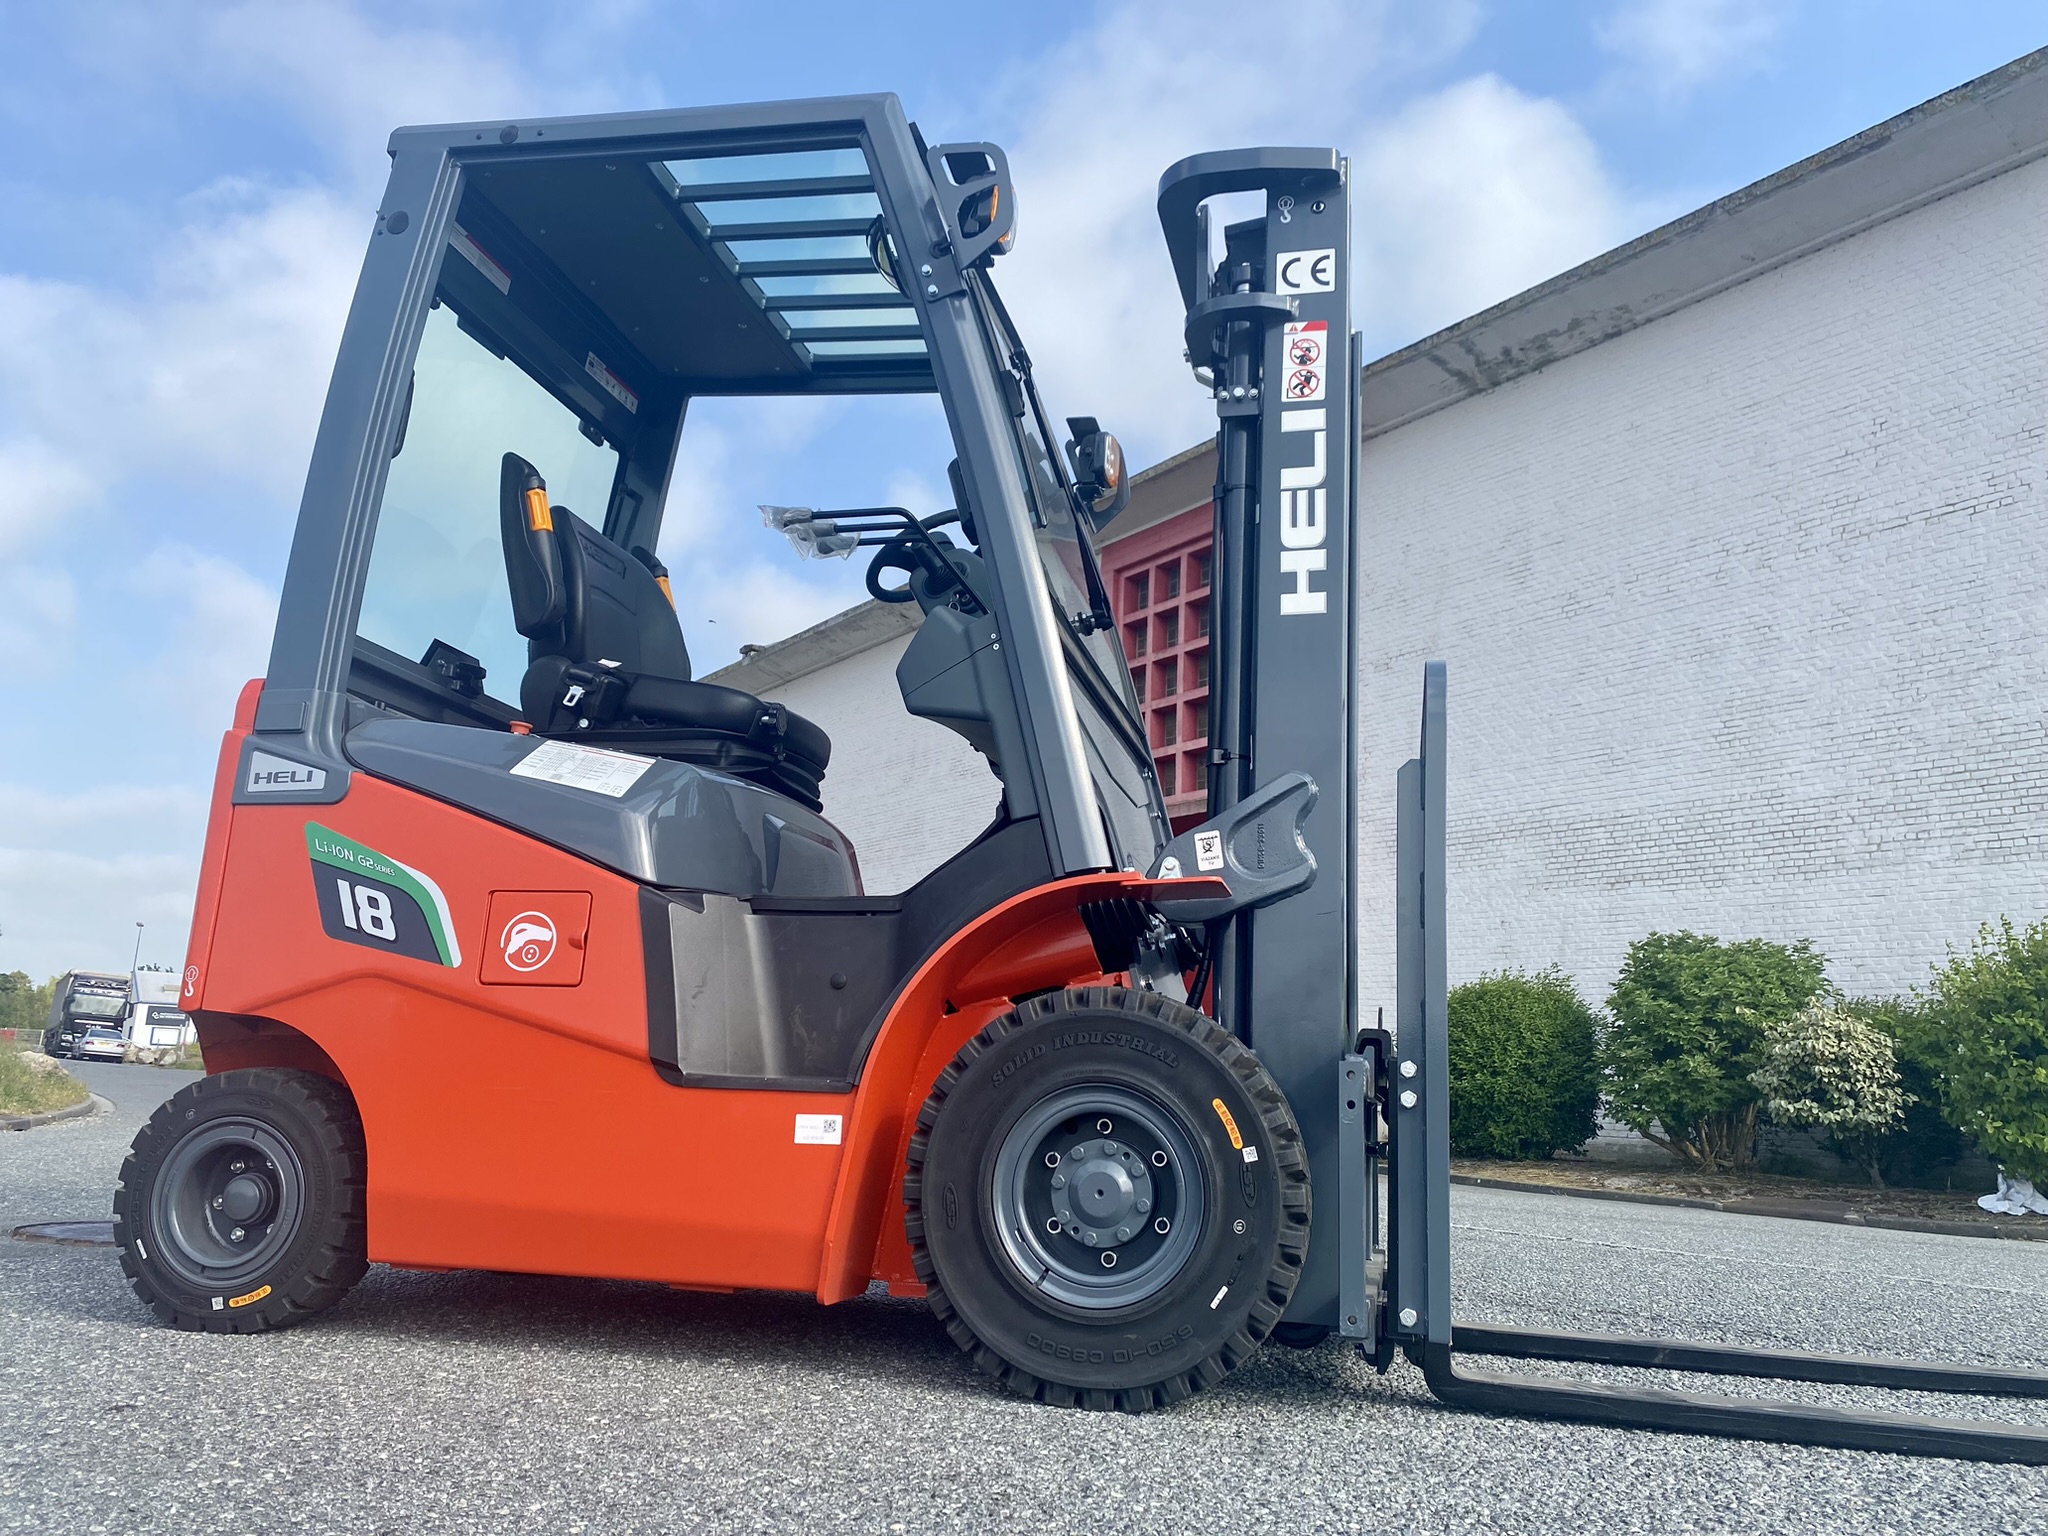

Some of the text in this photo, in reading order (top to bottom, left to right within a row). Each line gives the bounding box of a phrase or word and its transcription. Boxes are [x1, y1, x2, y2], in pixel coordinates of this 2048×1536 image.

[1281, 255, 1331, 289] CE
[1280, 408, 1328, 616] HELI
[253, 770, 314, 785] HELI
[315, 838, 354, 862] Li-ION
[337, 878, 397, 941] 18
[992, 1031, 1179, 1087] SOLID INDUSTRIAL
[1025, 1323, 1194, 1364] 6.50-10 C8900
